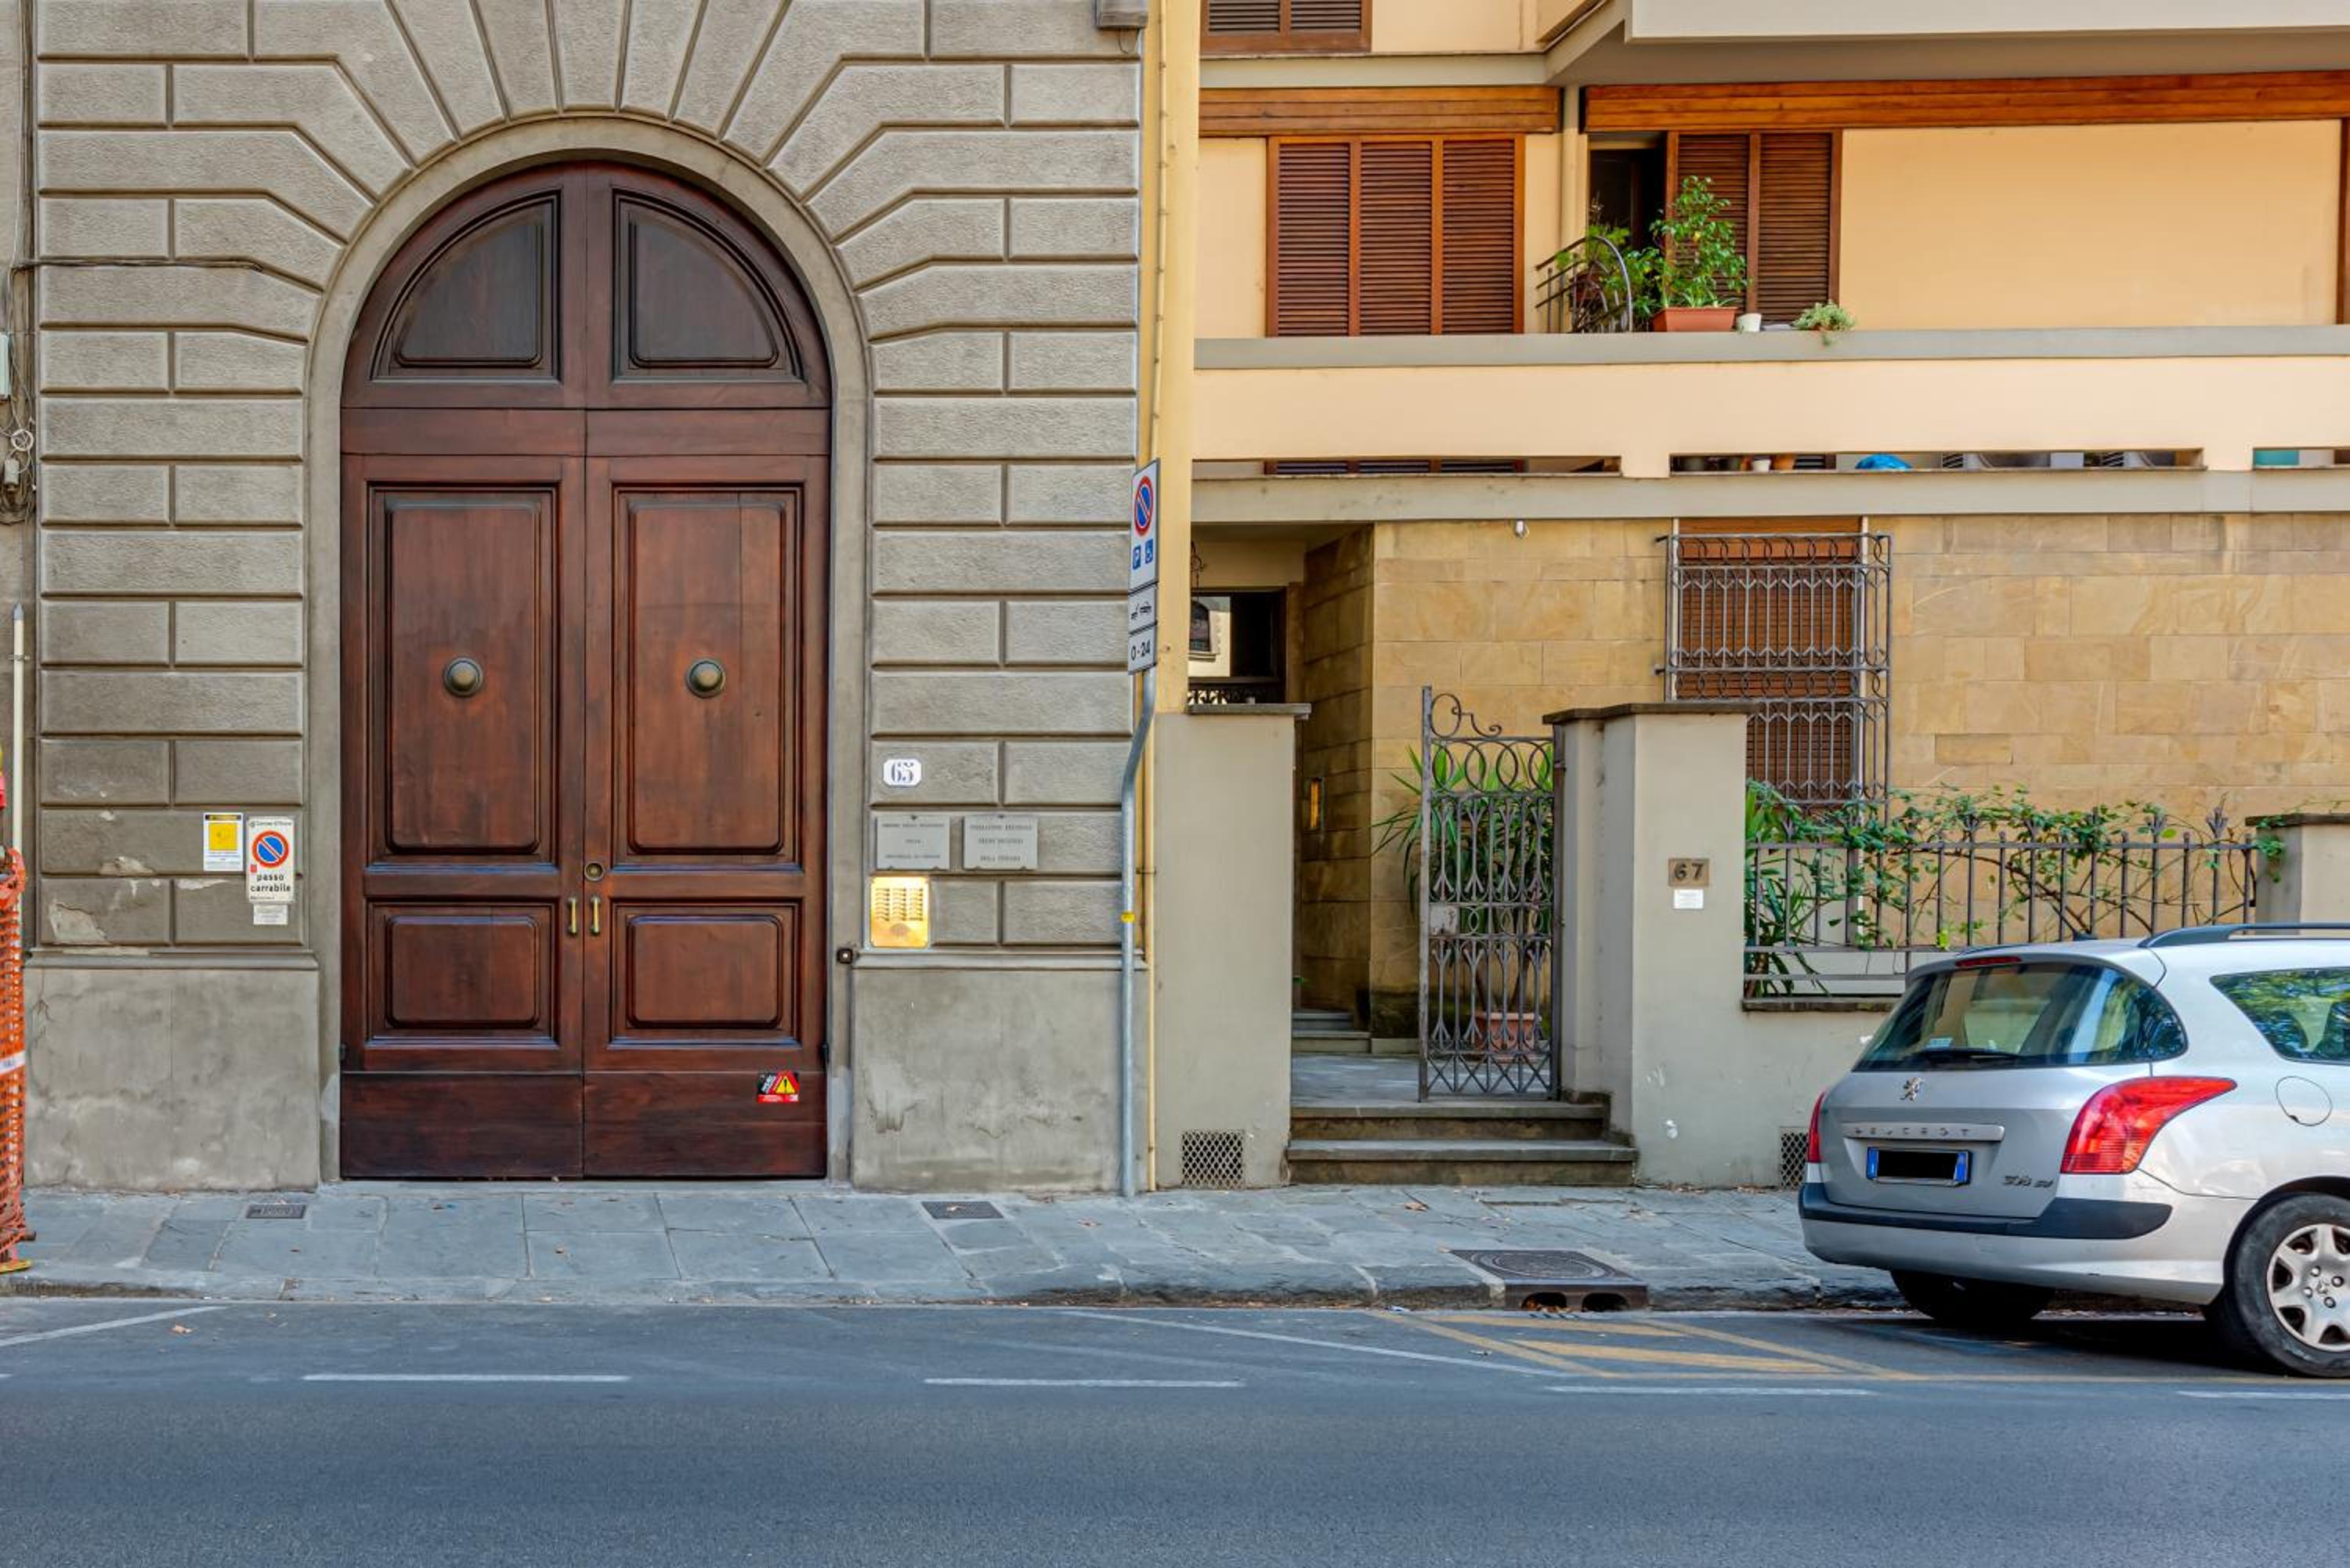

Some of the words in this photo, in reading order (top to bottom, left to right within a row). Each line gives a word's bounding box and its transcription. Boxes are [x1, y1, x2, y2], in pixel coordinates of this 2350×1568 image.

[891, 761, 914, 782] 65
[256, 873, 284, 882] passo
[1674, 862, 1705, 881] 67
[250, 883, 291, 892] carrabile
